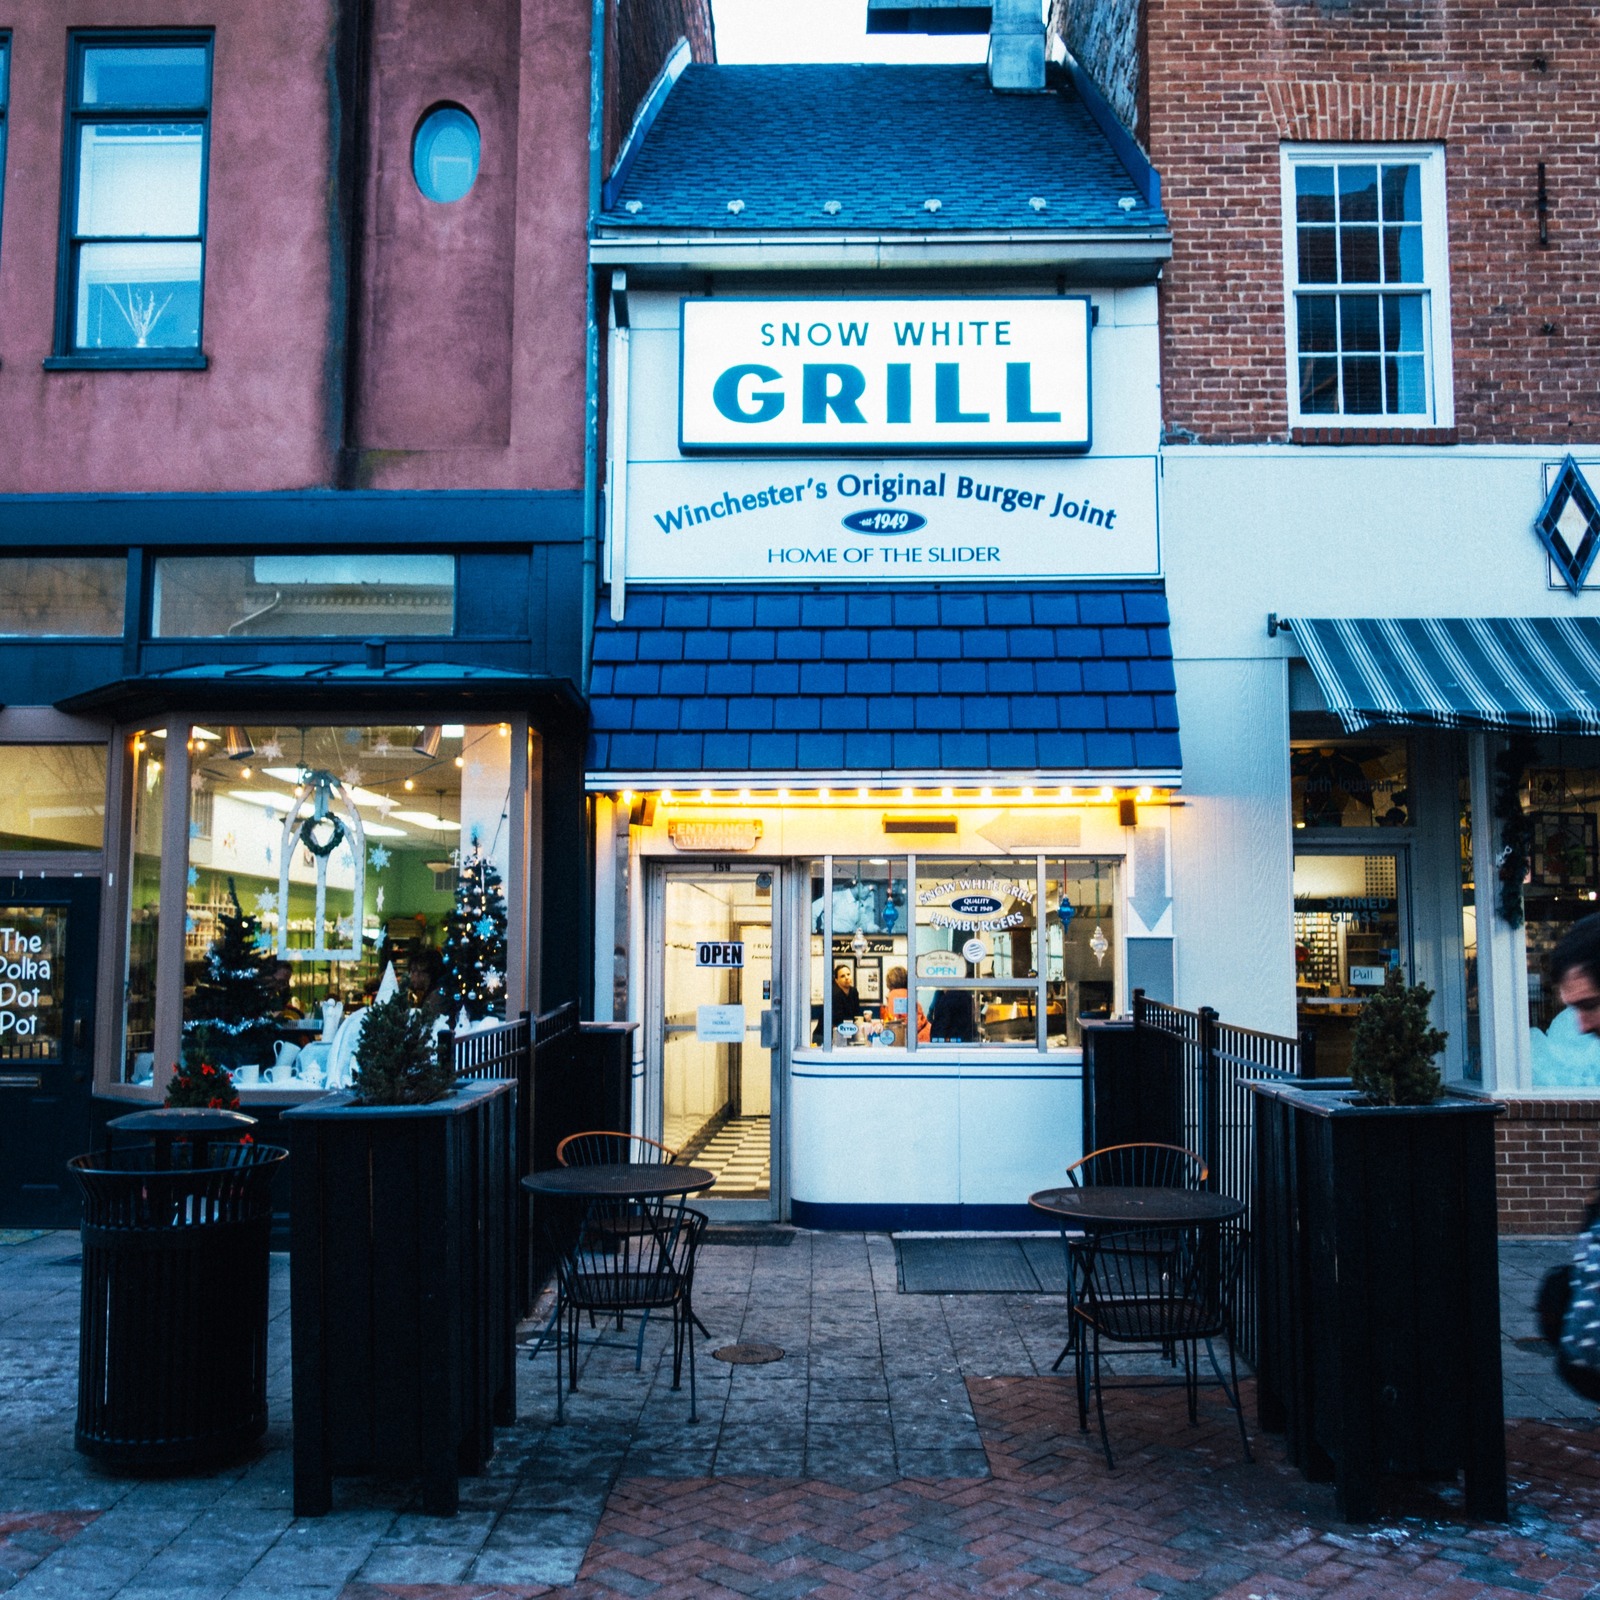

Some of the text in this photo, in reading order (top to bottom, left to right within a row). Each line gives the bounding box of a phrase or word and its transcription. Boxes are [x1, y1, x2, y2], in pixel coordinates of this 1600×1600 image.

[761, 320, 1012, 346] SNOW WHITE
[712, 362, 1062, 424] GRILL
[654, 472, 1118, 535] Winchester's Original Burger Joint
[874, 513, 909, 530] 1949
[768, 546, 1001, 564] HOME OF THE SLIDER
[676, 823, 753, 836] ENTRANCE
[713, 863, 731, 872] 159
[919, 880, 1034, 905] SNOW WHITE GRILL
[1326, 896, 1389, 909] STAINED
[930, 912, 1024, 932] HAMBURGERS
[1330, 911, 1380, 923] GLASS
[0, 927, 42, 953] The
[700, 944, 742, 964] OPEN
[926, 966, 957, 976] OPEN
[1353, 969, 1373, 980] Pull
[0, 983, 40, 1008] Dot
[0, 1011, 38, 1036] Pot
